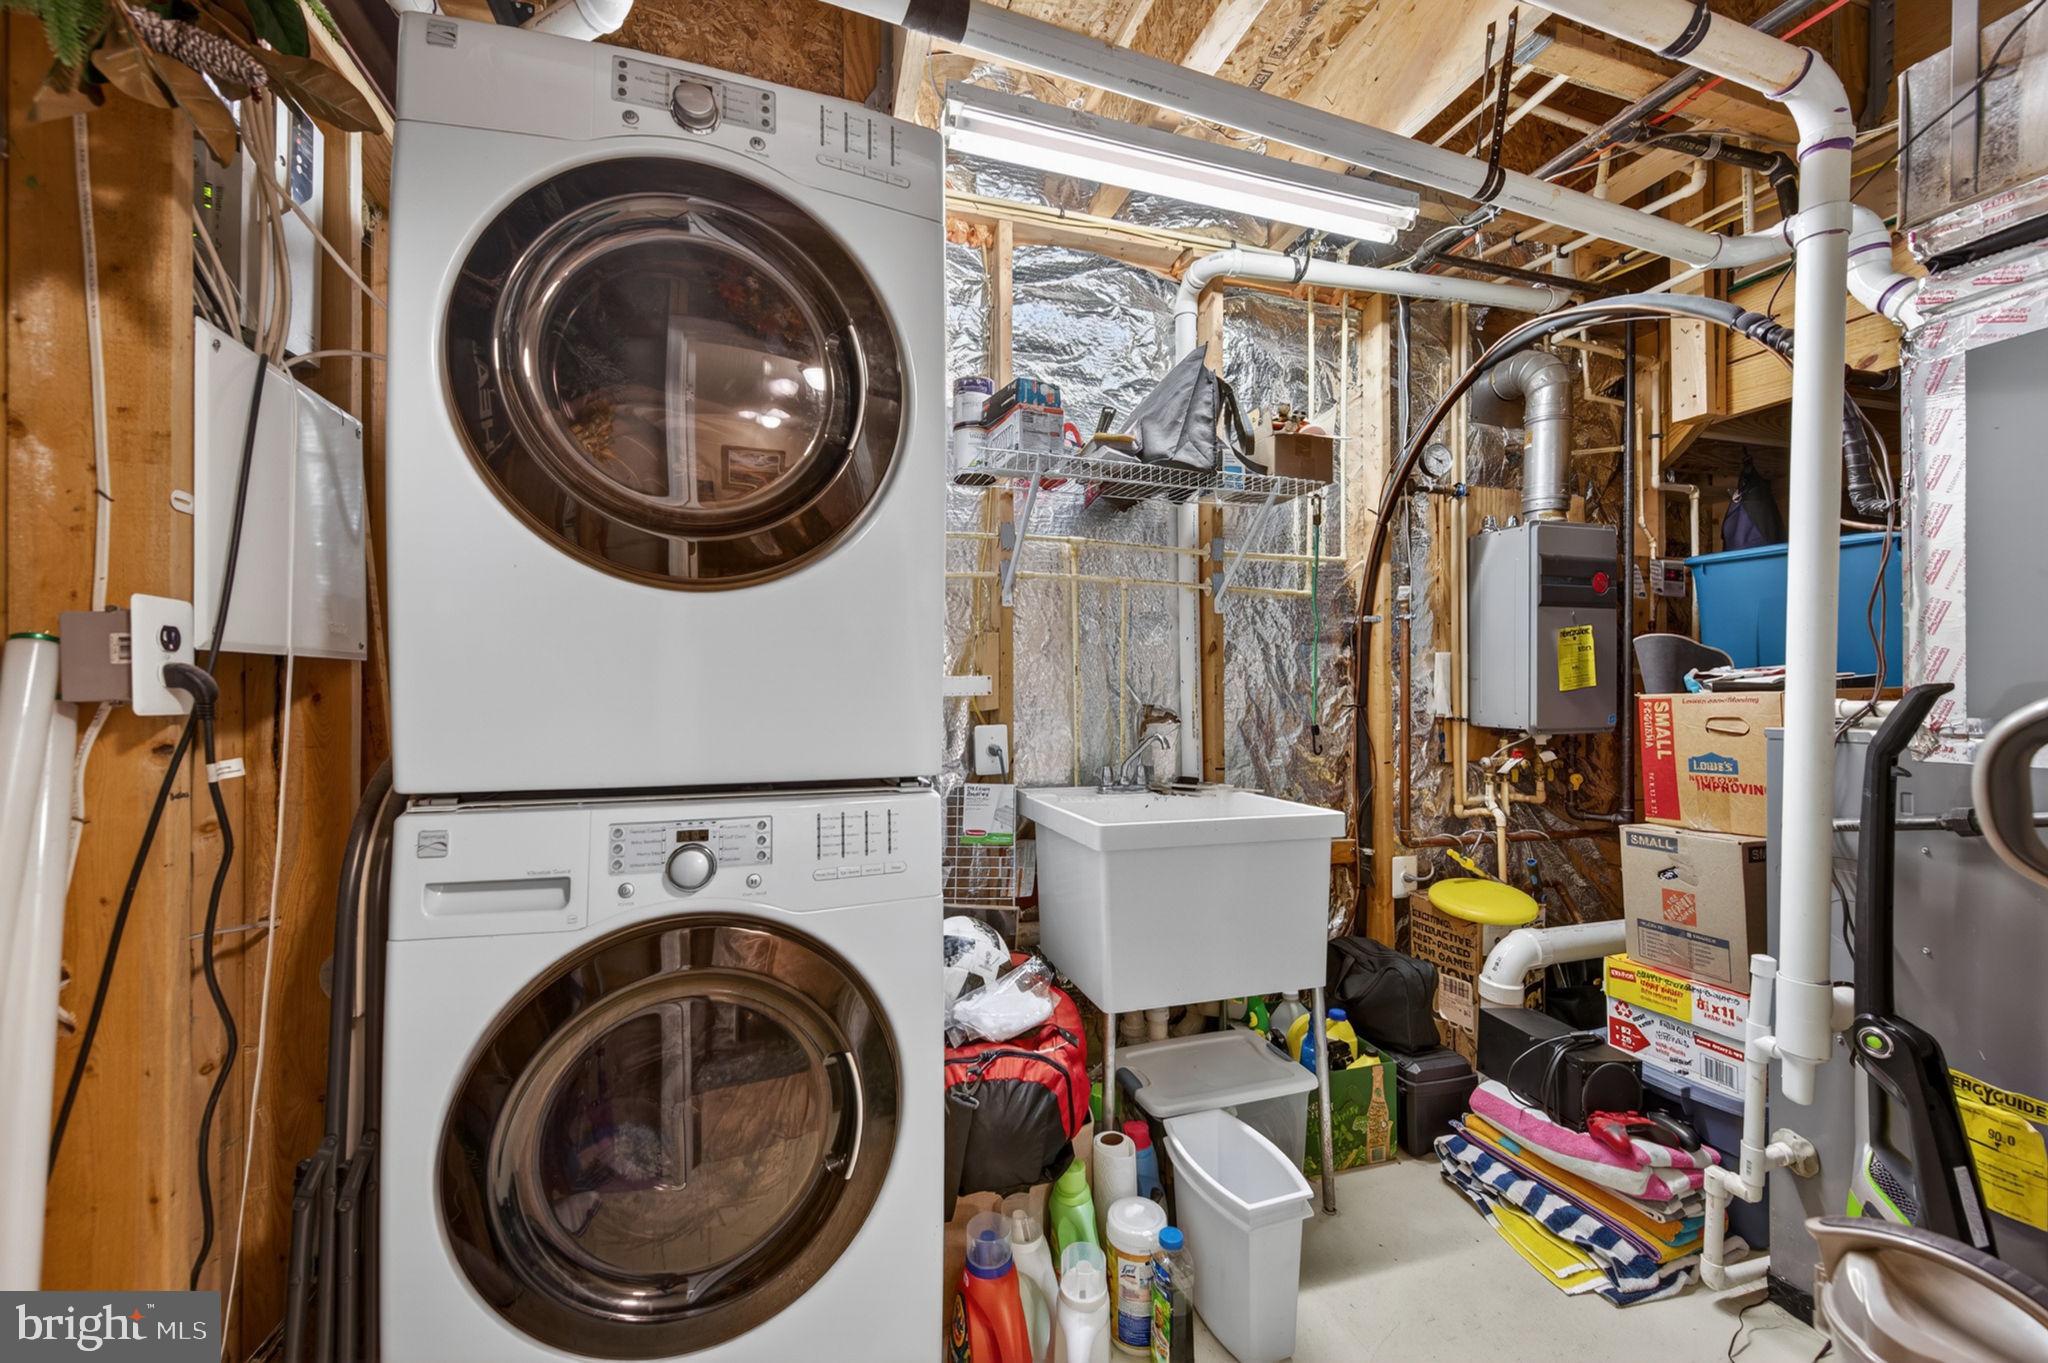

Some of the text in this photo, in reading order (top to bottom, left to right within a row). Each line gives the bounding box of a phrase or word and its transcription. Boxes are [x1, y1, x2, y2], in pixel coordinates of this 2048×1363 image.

[1653, 700, 1673, 761] SMALL
[1696, 778, 1767, 797] IMPROVIN
[1630, 834, 1674, 850] SMALL
[1951, 1076, 2048, 1119] ERGYGUIDE
